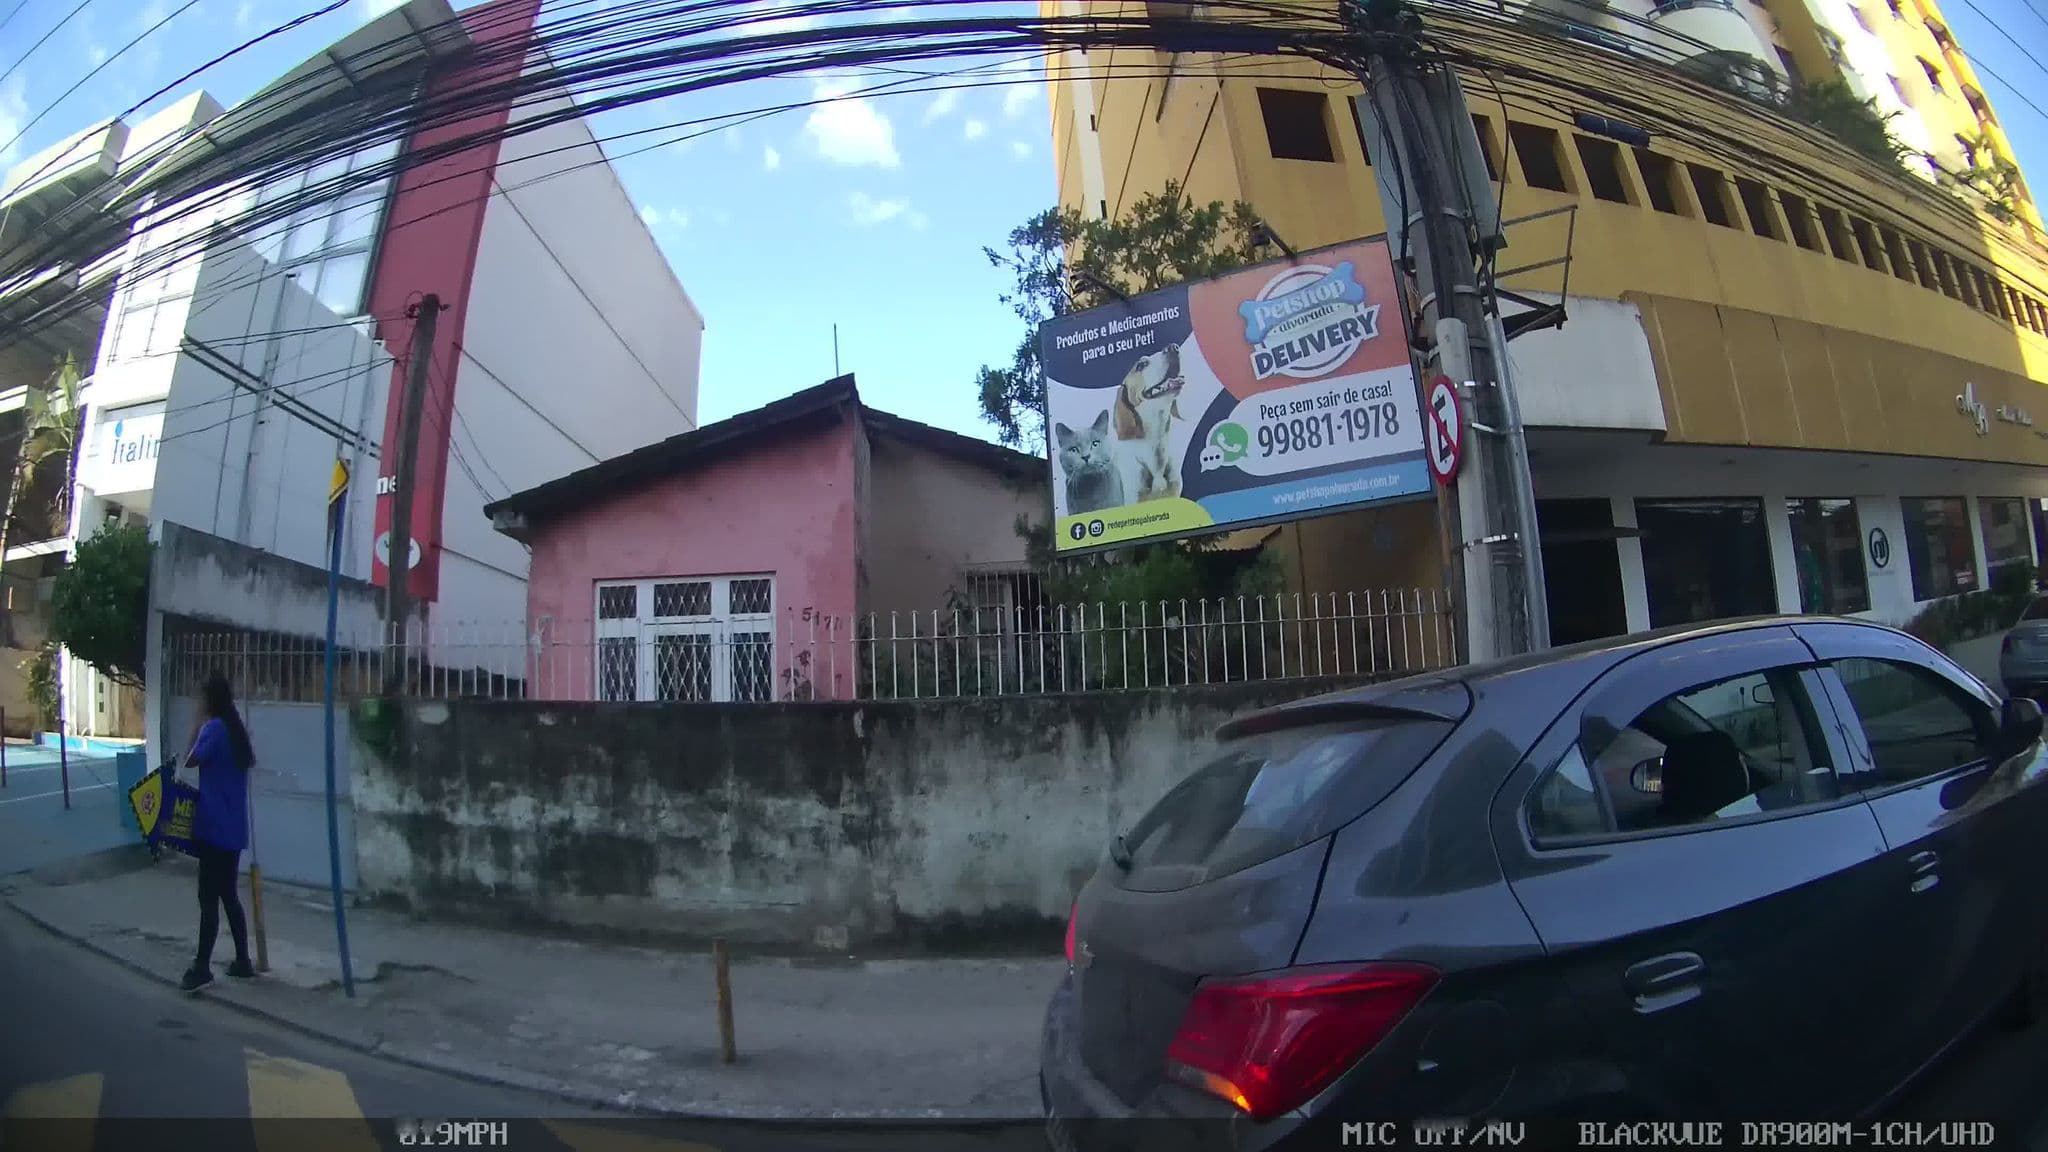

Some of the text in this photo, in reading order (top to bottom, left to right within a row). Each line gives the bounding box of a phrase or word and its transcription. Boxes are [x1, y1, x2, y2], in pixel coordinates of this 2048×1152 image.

[1056, 306, 1180, 350] Produtos e Medicamentos
[1279, 304, 1335, 333] alvorada
[1082, 329, 1155, 364] para o seu Pet!
[1254, 309, 1375, 376] DELIVERY
[1260, 380, 1393, 421] Peça sem sair de casa!
[1257, 401, 1400, 458] 99881-1978
